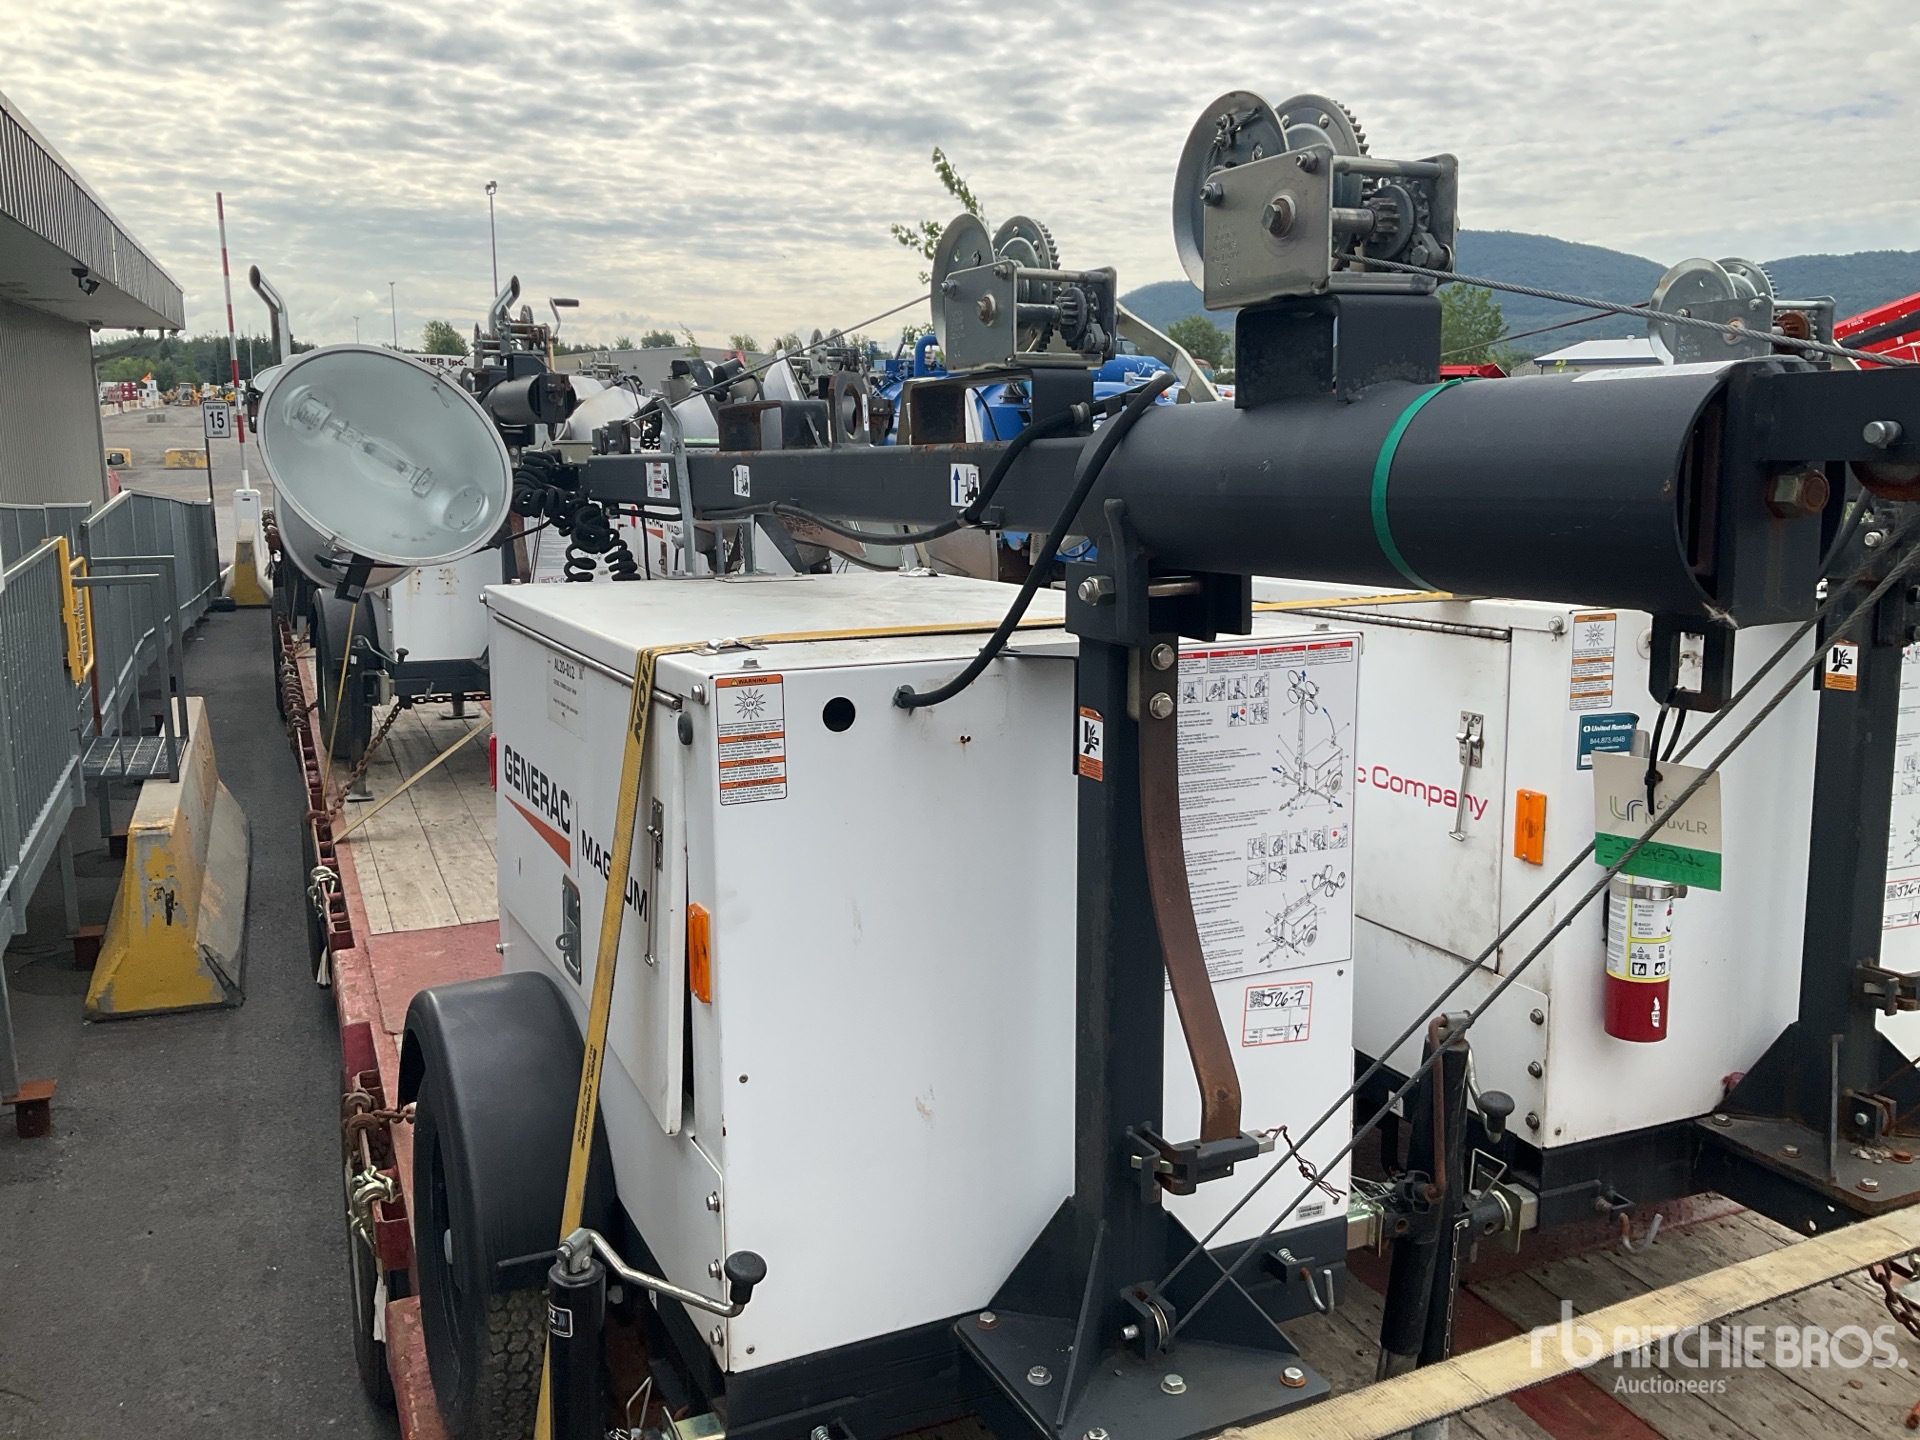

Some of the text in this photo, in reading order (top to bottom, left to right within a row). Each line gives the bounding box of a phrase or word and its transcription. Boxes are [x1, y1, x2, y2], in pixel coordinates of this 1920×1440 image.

[448, 358, 467, 366] Inc.
[209, 411, 225, 429] 15
[738, 677, 768, 685] WARNING
[745, 700, 755, 708] UV
[1591, 724, 1611, 732] United
[505, 744, 571, 835] GENERAC
[1372, 766, 1488, 820] Company
[1645, 813, 1708, 835] NuvLR
[581, 829, 648, 922] MAGUM
